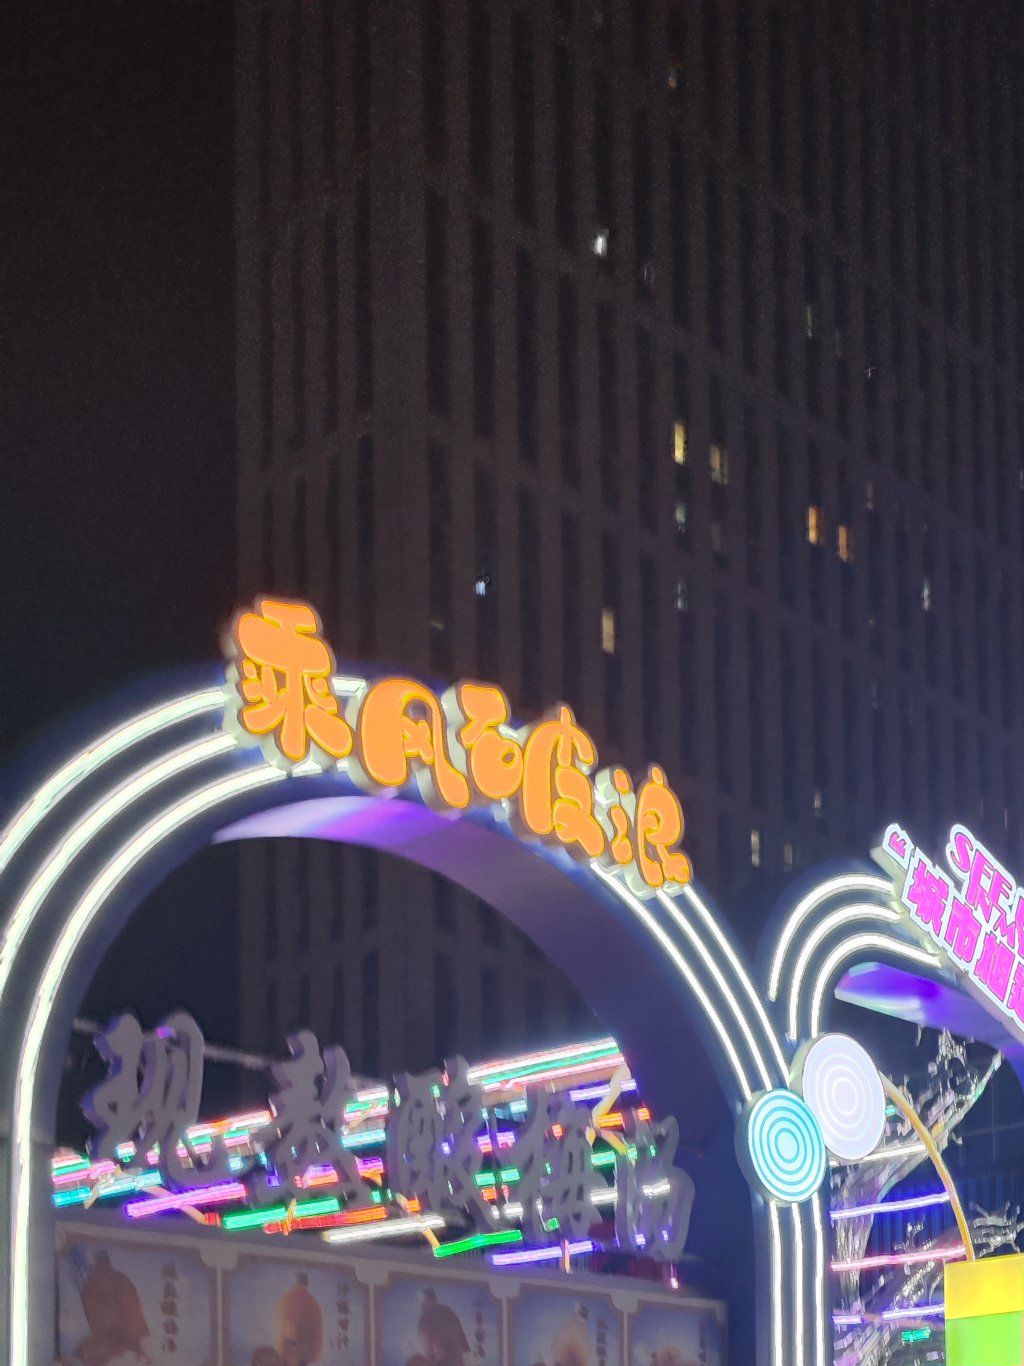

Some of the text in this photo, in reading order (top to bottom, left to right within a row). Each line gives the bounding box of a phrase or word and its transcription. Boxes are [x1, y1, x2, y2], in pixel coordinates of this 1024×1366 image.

[236, 600, 692, 889] 乘风破浪
[950, 832, 1012, 907] SEE
